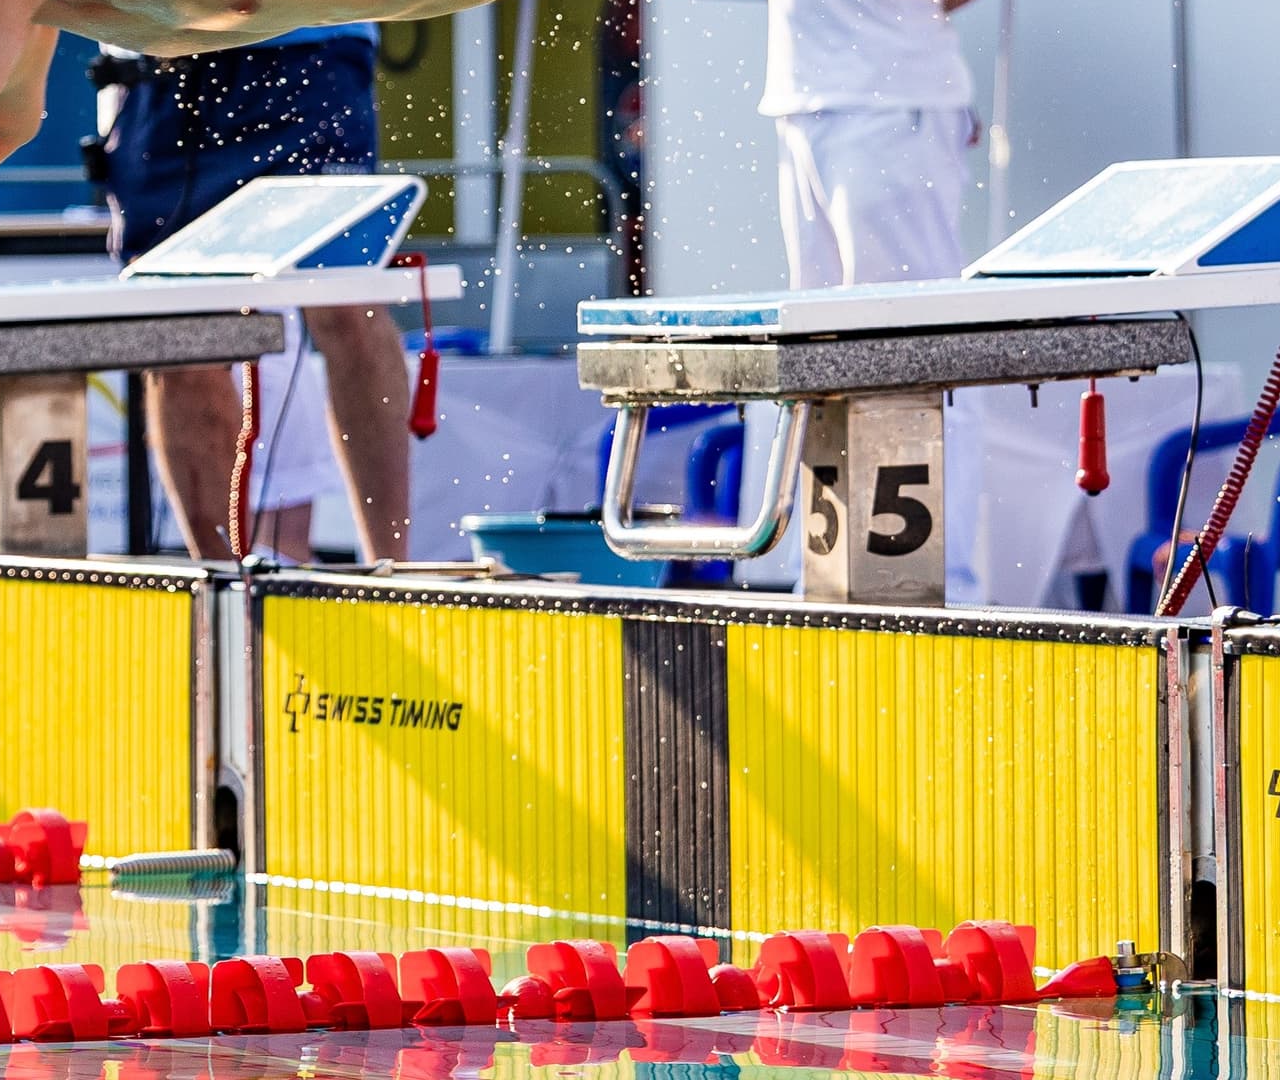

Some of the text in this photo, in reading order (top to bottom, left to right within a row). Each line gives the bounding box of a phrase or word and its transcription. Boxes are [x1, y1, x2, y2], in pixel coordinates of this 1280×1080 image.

[17, 440, 81, 514] 4
[807, 465, 839, 556] 5
[866, 464, 933, 557] 5
[314, 693, 463, 731] SWISS TIMING
